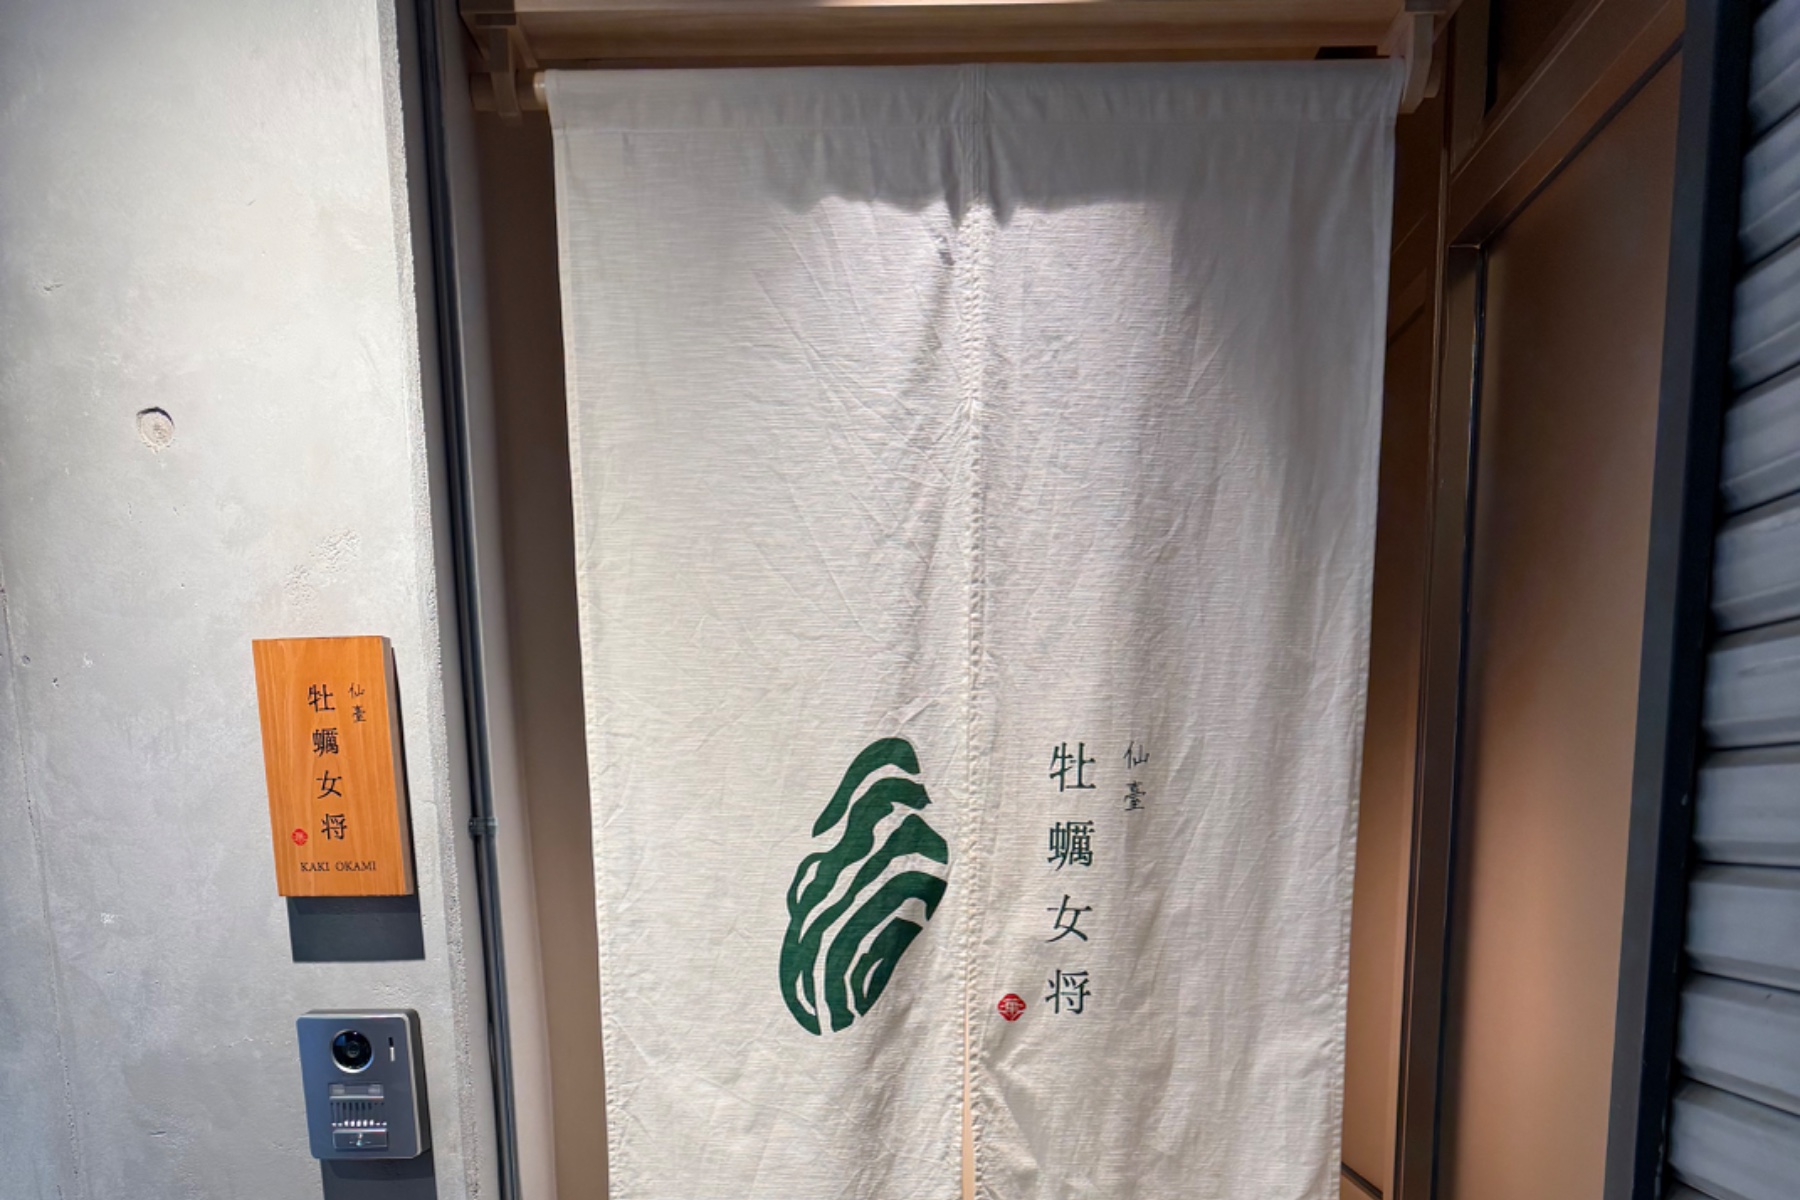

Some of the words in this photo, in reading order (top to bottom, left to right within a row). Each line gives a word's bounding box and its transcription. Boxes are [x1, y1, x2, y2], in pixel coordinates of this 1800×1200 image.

[347, 682, 367, 723] 仙臺
[307, 684, 348, 841] 牡蠣女将
[1122, 740, 1150, 811] 仙臺
[300, 861, 330, 872] KAKI
[336, 860, 377, 872] OKAMI
[1045, 741, 1097, 1015] 牡蠣女将
